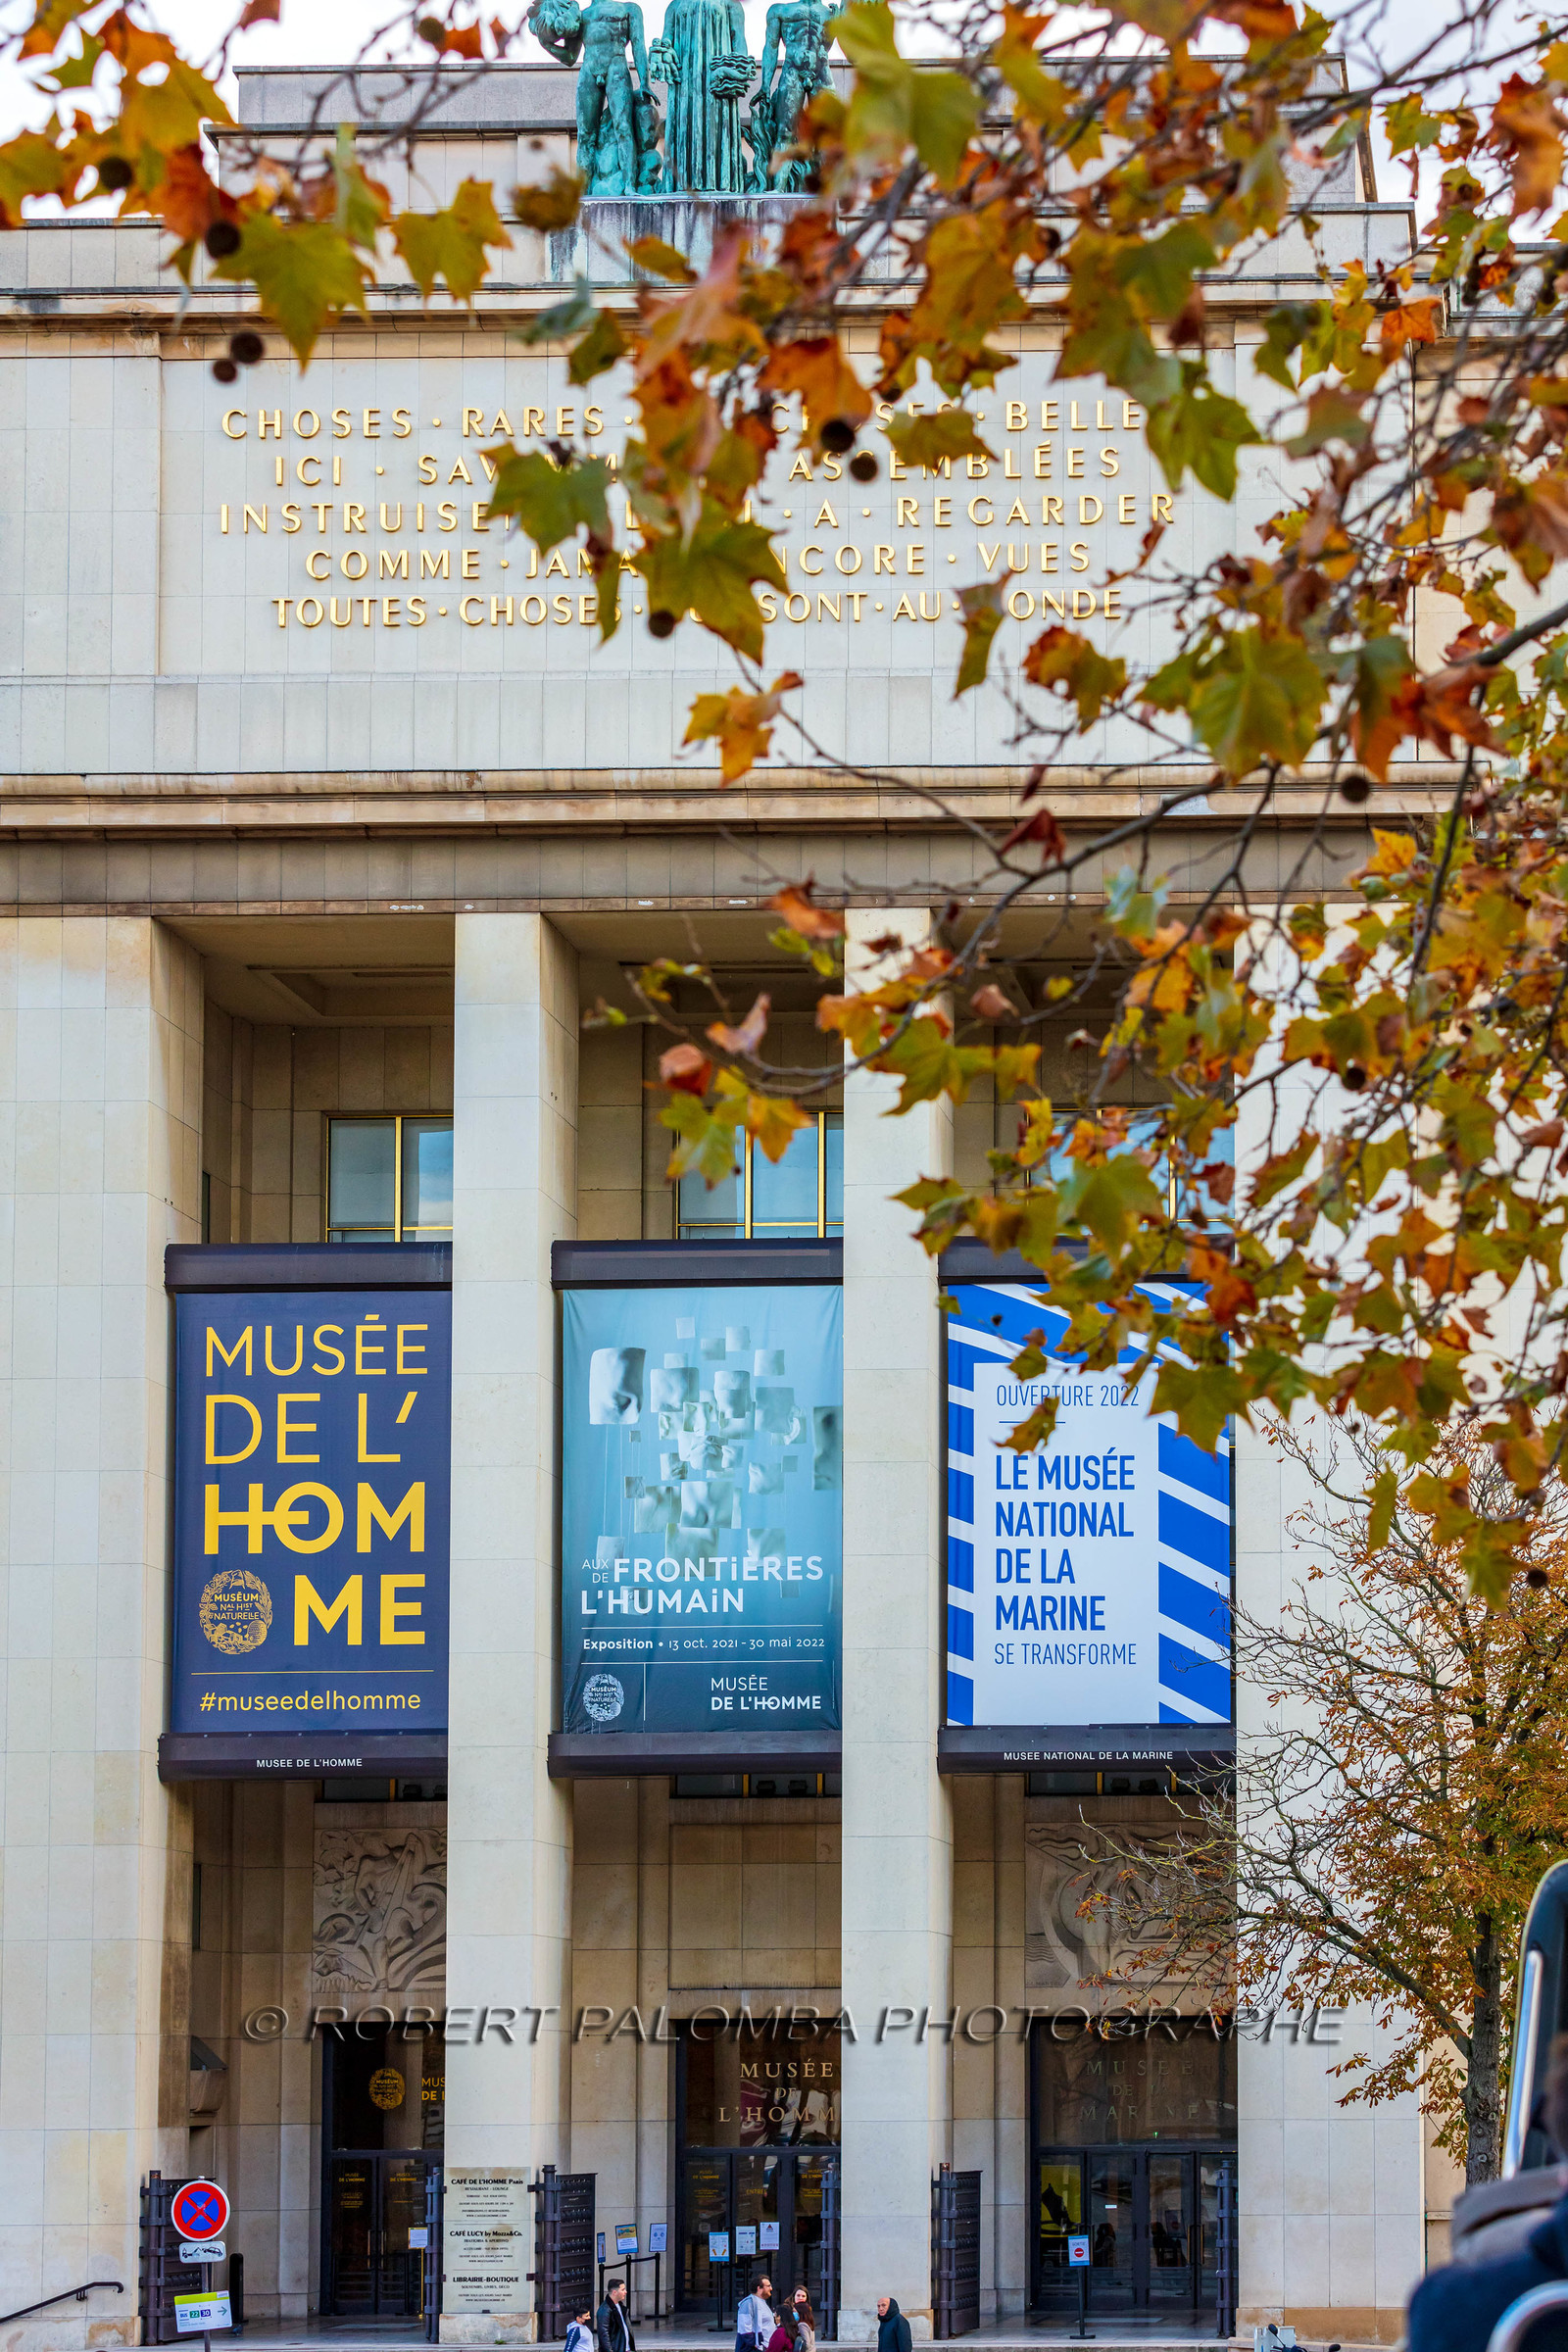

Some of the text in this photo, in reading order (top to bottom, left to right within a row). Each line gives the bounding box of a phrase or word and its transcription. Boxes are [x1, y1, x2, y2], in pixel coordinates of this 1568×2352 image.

[221, 408, 413, 439] CHOSES
[462, 406, 605, 437] RARES
[1005, 400, 1141, 431] BELLE
[274, 439, 1121, 486] ICI ASEMBLÉES
[814, 498, 840, 528] A
[897, 493, 1175, 527] REGARDER
[305, 550, 480, 581] COMME
[977, 542, 1091, 574] VUES
[272, 598, 428, 628] TOUTES
[757, 592, 868, 623] SONT
[893, 592, 941, 622] AU
[1006, 589, 1122, 620] ONDE
[206, 1314, 429, 1377] MUSÉE
[997, 1385, 1140, 1407] OUVERTURE 2022
[205, 1393, 321, 1465] DE
[996, 1447, 1135, 1491] LE MUSÉE
[995, 1501, 1135, 1538] NATIONAL
[581, 1558, 610, 1570] AUX
[995, 1548, 1076, 1585] DE LA
[592, 1572, 610, 1584] DE
[294, 1574, 426, 1646] ME
[995, 1594, 1106, 1632] MARINE
[583, 1637, 825, 1652] Exposition 13 oct. 2021 30 mai 2022
[994, 1642, 1137, 1666] SE TRANSFORME
[710, 1674, 769, 1691] MUSÉE
[200, 1689, 422, 1713] #museedelhomme
[710, 1695, 822, 1711] DE L'HOMME
[256, 1758, 364, 1769] MUSEE DE L'HOMME
[1004, 1750, 1173, 1762] MUSEE NATIONAL DE LA MARINE
[740, 2058, 834, 2078] MUSÉE
[421, 2077, 446, 2087] MUS
[421, 2090, 437, 2101] DE
[718, 2106, 836, 2123] L'HOMM
